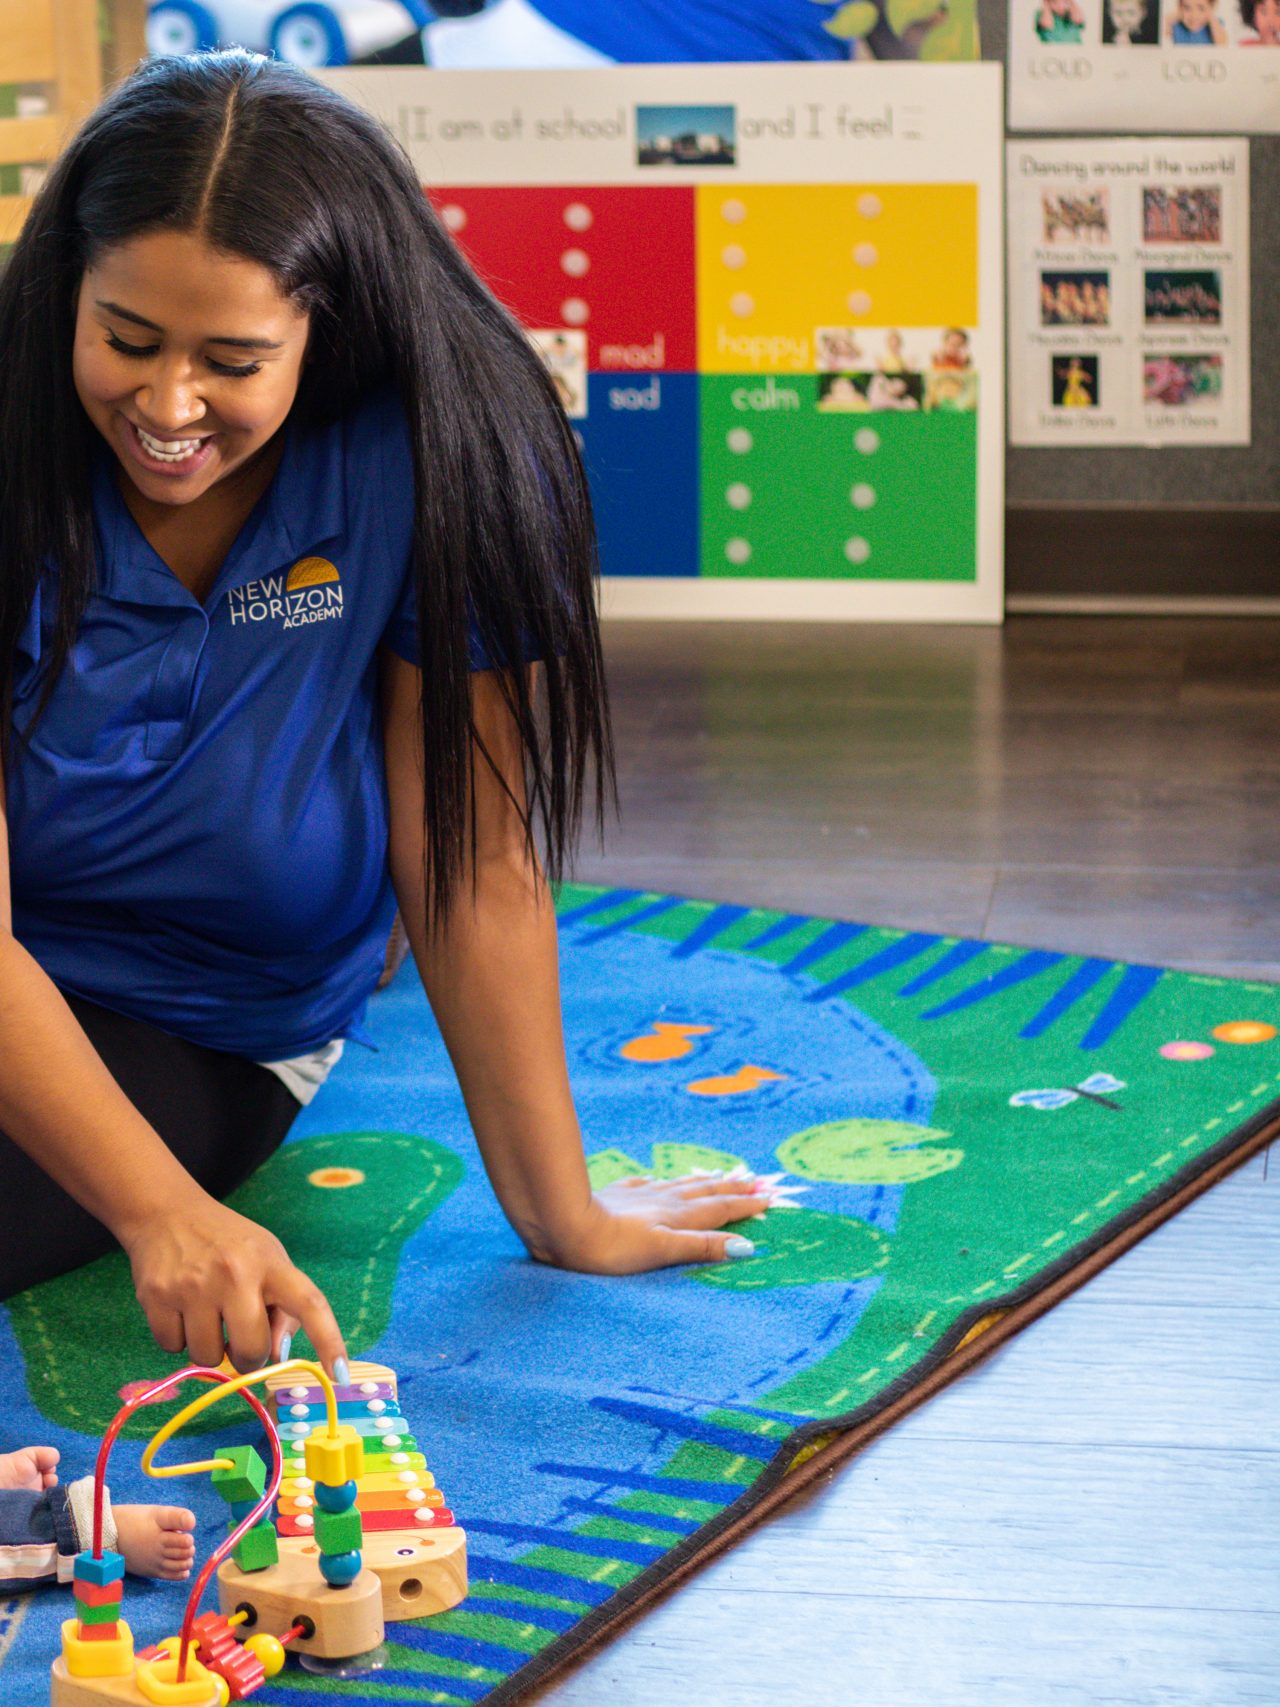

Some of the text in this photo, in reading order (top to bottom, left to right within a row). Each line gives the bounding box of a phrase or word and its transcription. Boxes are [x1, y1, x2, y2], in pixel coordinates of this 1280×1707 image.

[1028, 57, 1092, 81] LOUD
[1161, 58, 1227, 83] LOUD
[438, 118, 484, 143] am
[490, 106, 524, 142] at
[535, 105, 626, 142] school
[740, 105, 796, 139] and
[805, 103, 824, 140] I
[837, 104, 894, 139] feel
[599, 331, 665, 368] mad
[717, 325, 808, 369] happy
[609, 375, 660, 411] sad
[731, 376, 800, 411] calm
[228, 576, 283, 604] NEW
[230, 585, 344, 625] HORIZON
[283, 606, 344, 630] ACADEMY
